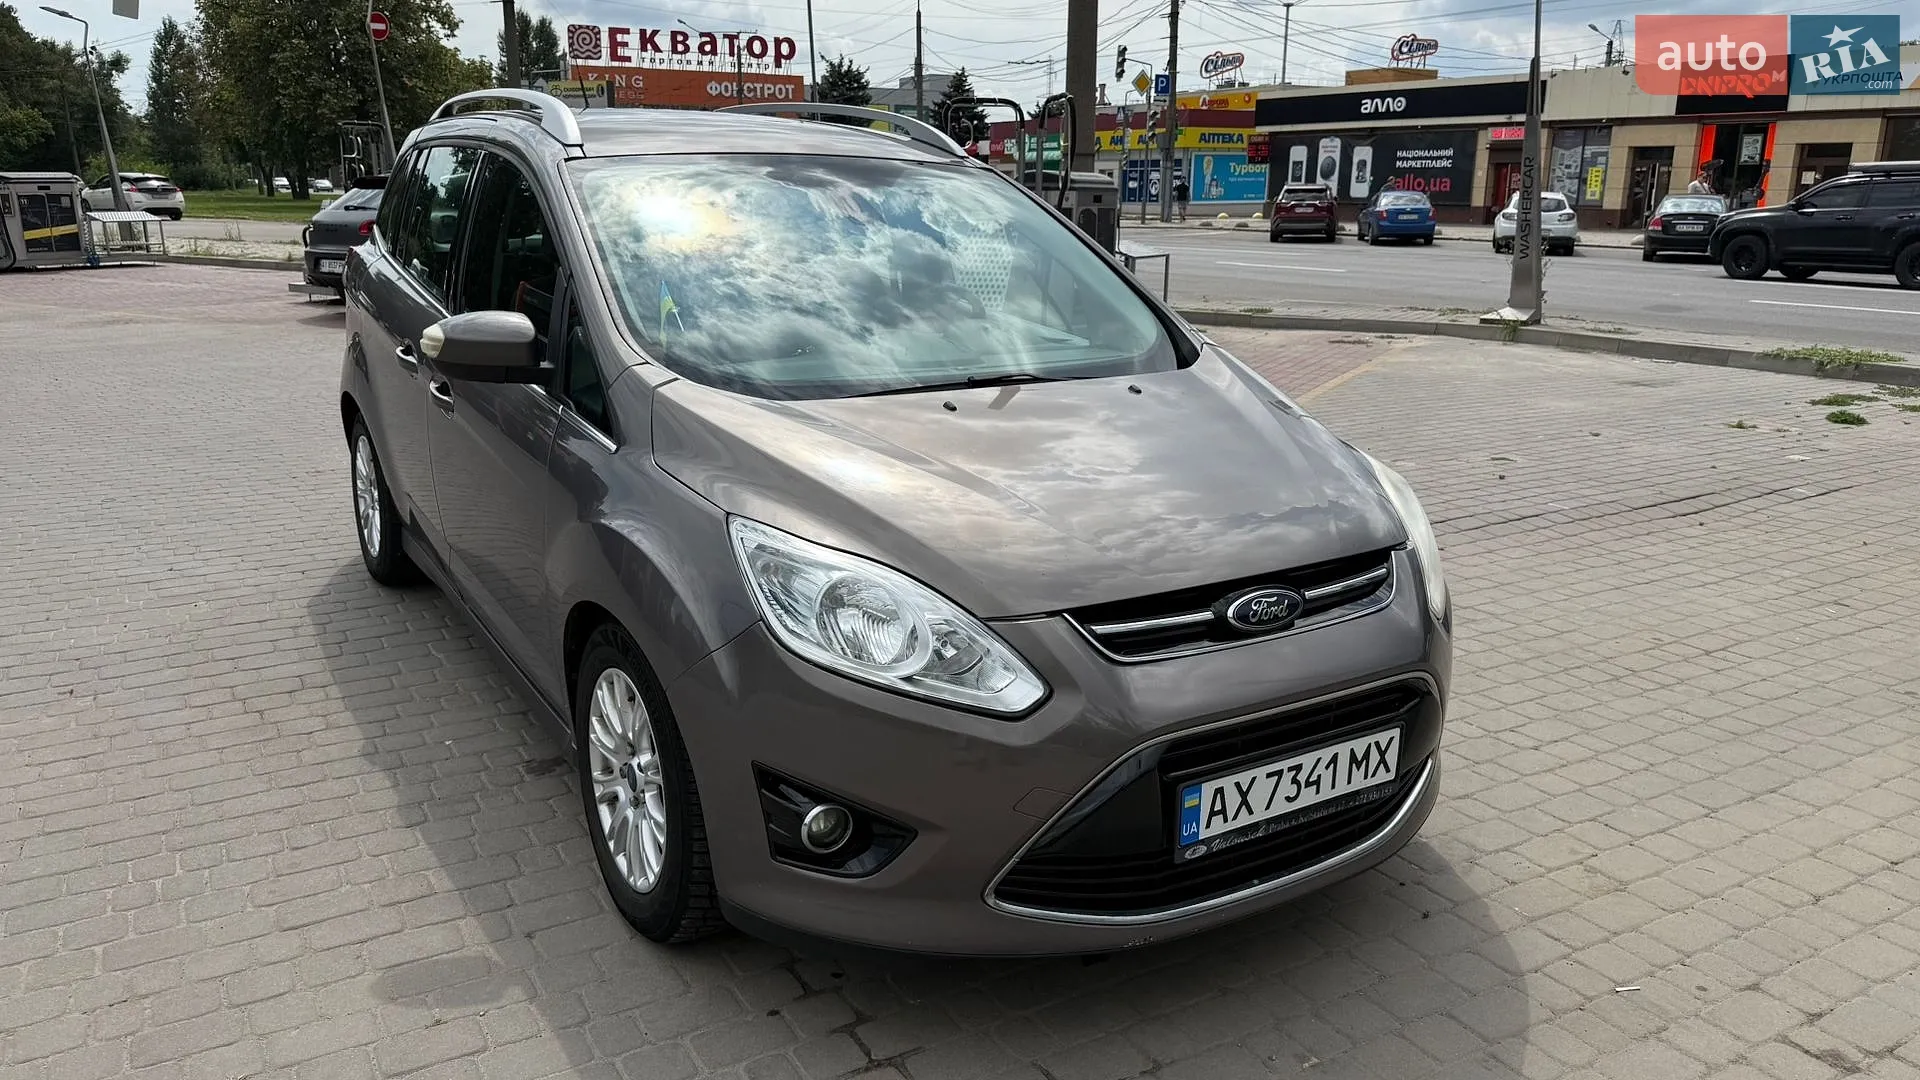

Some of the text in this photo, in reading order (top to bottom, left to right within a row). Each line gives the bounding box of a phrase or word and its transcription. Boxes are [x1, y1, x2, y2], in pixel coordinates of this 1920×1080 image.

[608, 27, 797, 68] Екватор
[641, 56, 715, 67] торговий
[1158, 77, 1167, 92] P
[1199, 132, 1244, 145] АПТЕКА
[1396, 147, 1454, 158] НАЦІОНАЛЬНИЙ
[1395, 158, 1453, 168] МАРКЕТПЛЕЙС
[1395, 173, 1451, 191] allo.ua
[1519, 156, 1534, 260] WASHERCAR
[1249, 596, 1289, 623] Ford
[1204, 775, 1258, 830] AX
[1264, 752, 1340, 811] 7341
[1346, 735, 1396, 786] MX
[1182, 824, 1198, 836] UA
